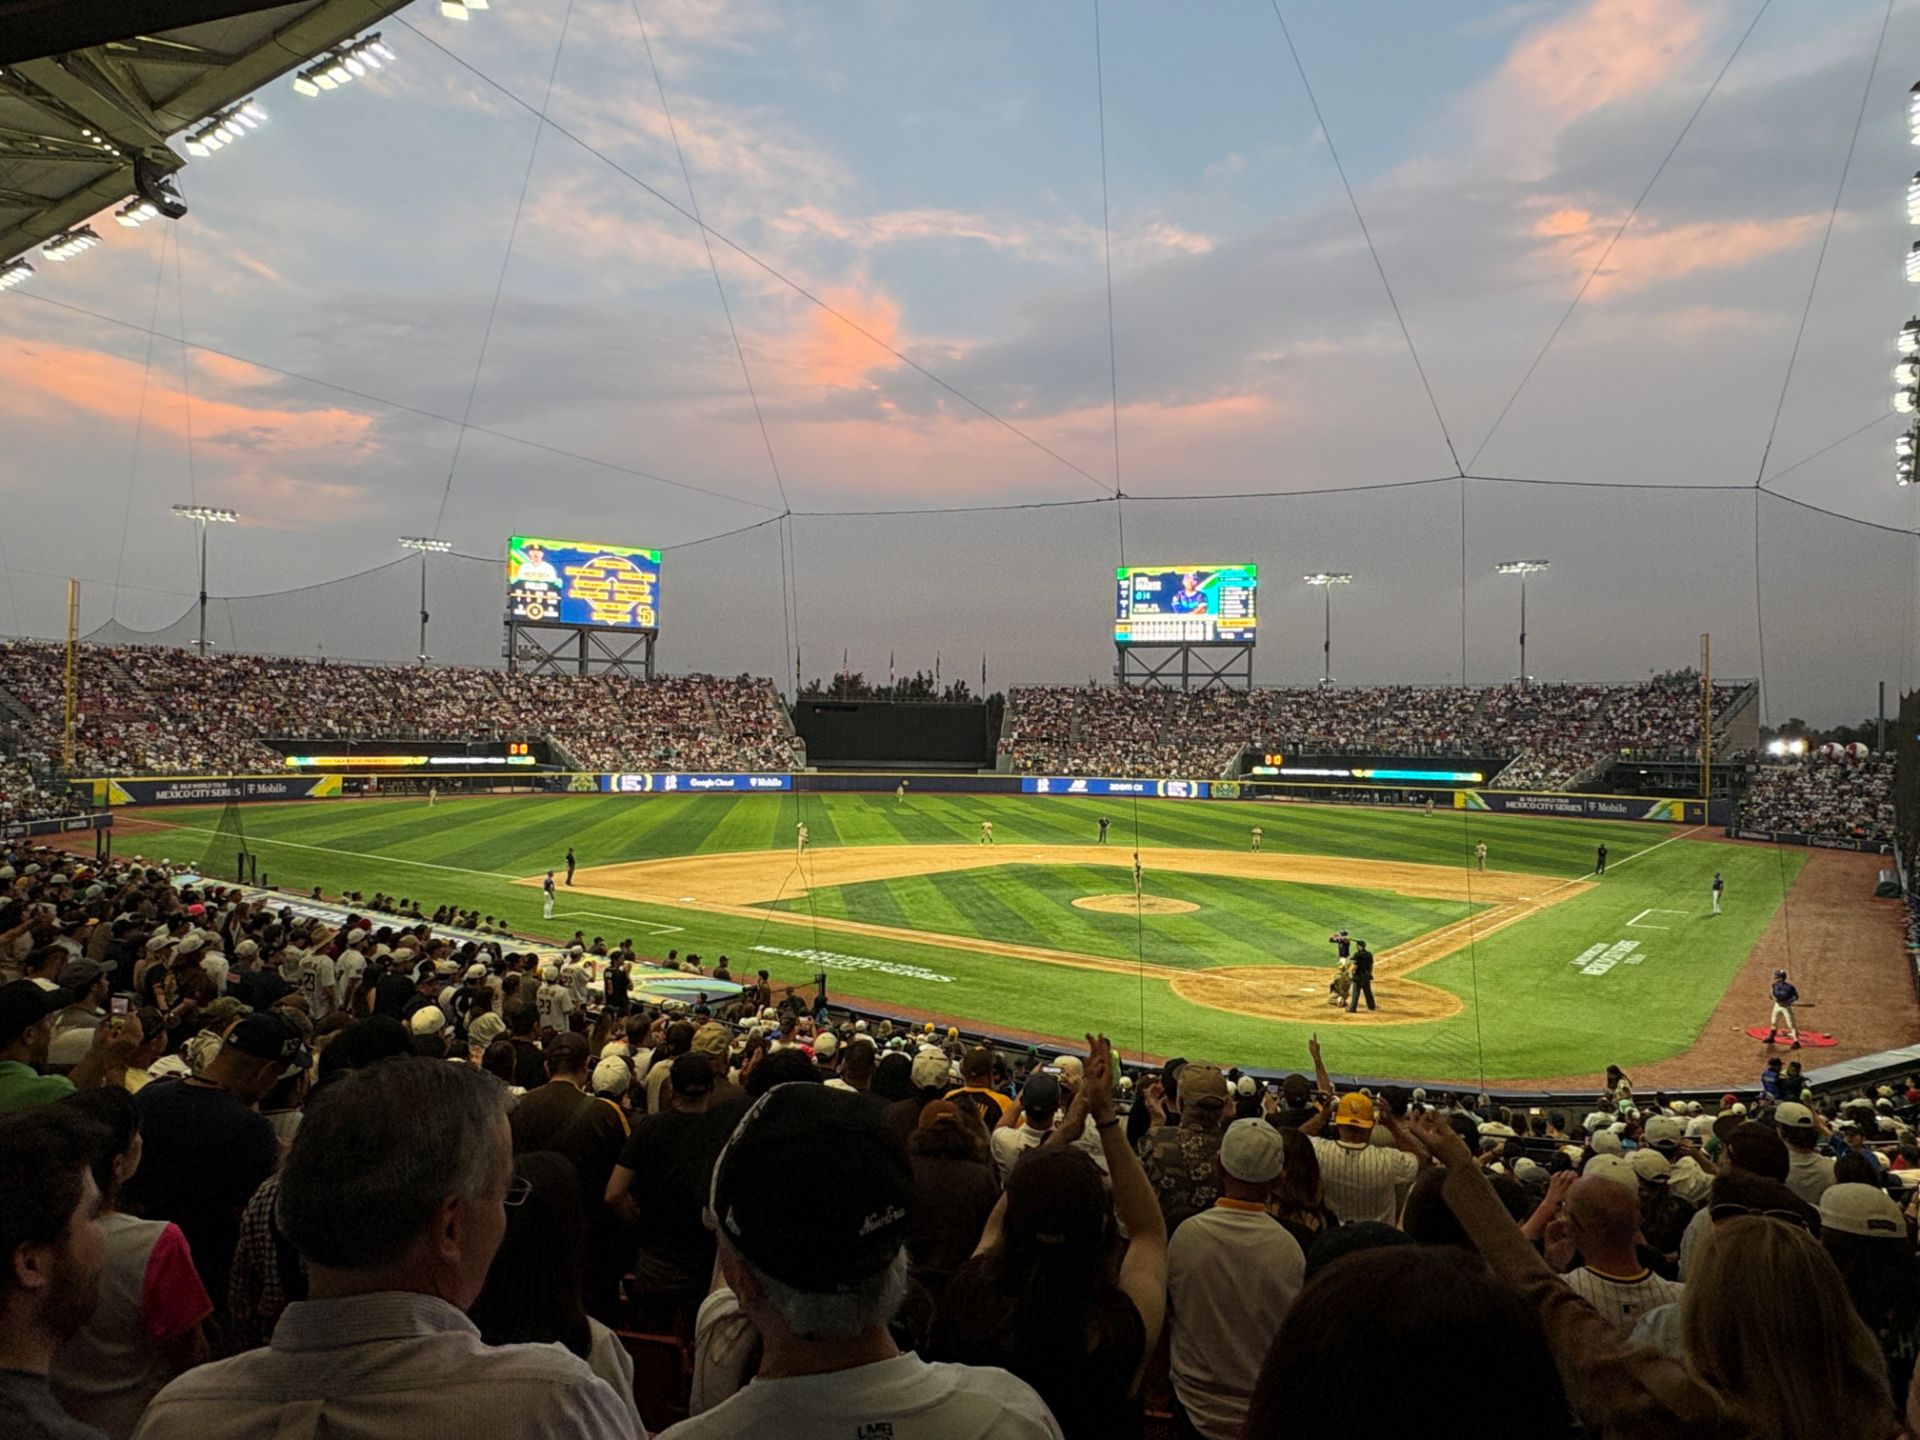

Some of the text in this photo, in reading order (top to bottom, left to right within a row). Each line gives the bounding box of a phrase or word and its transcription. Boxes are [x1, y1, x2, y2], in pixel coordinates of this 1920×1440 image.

[690, 778, 735, 788] Google Cloud
[758, 778, 782, 787] Mobile
[256, 783, 287, 794] Mobile
[156, 790, 191, 800] MEXICO
[191, 789, 210, 799] CITY
[1505, 801, 1582, 812] MEXICO CITY SERIES
[1598, 802, 1627, 813] Mobile
[539, 998, 552, 1015] 23
